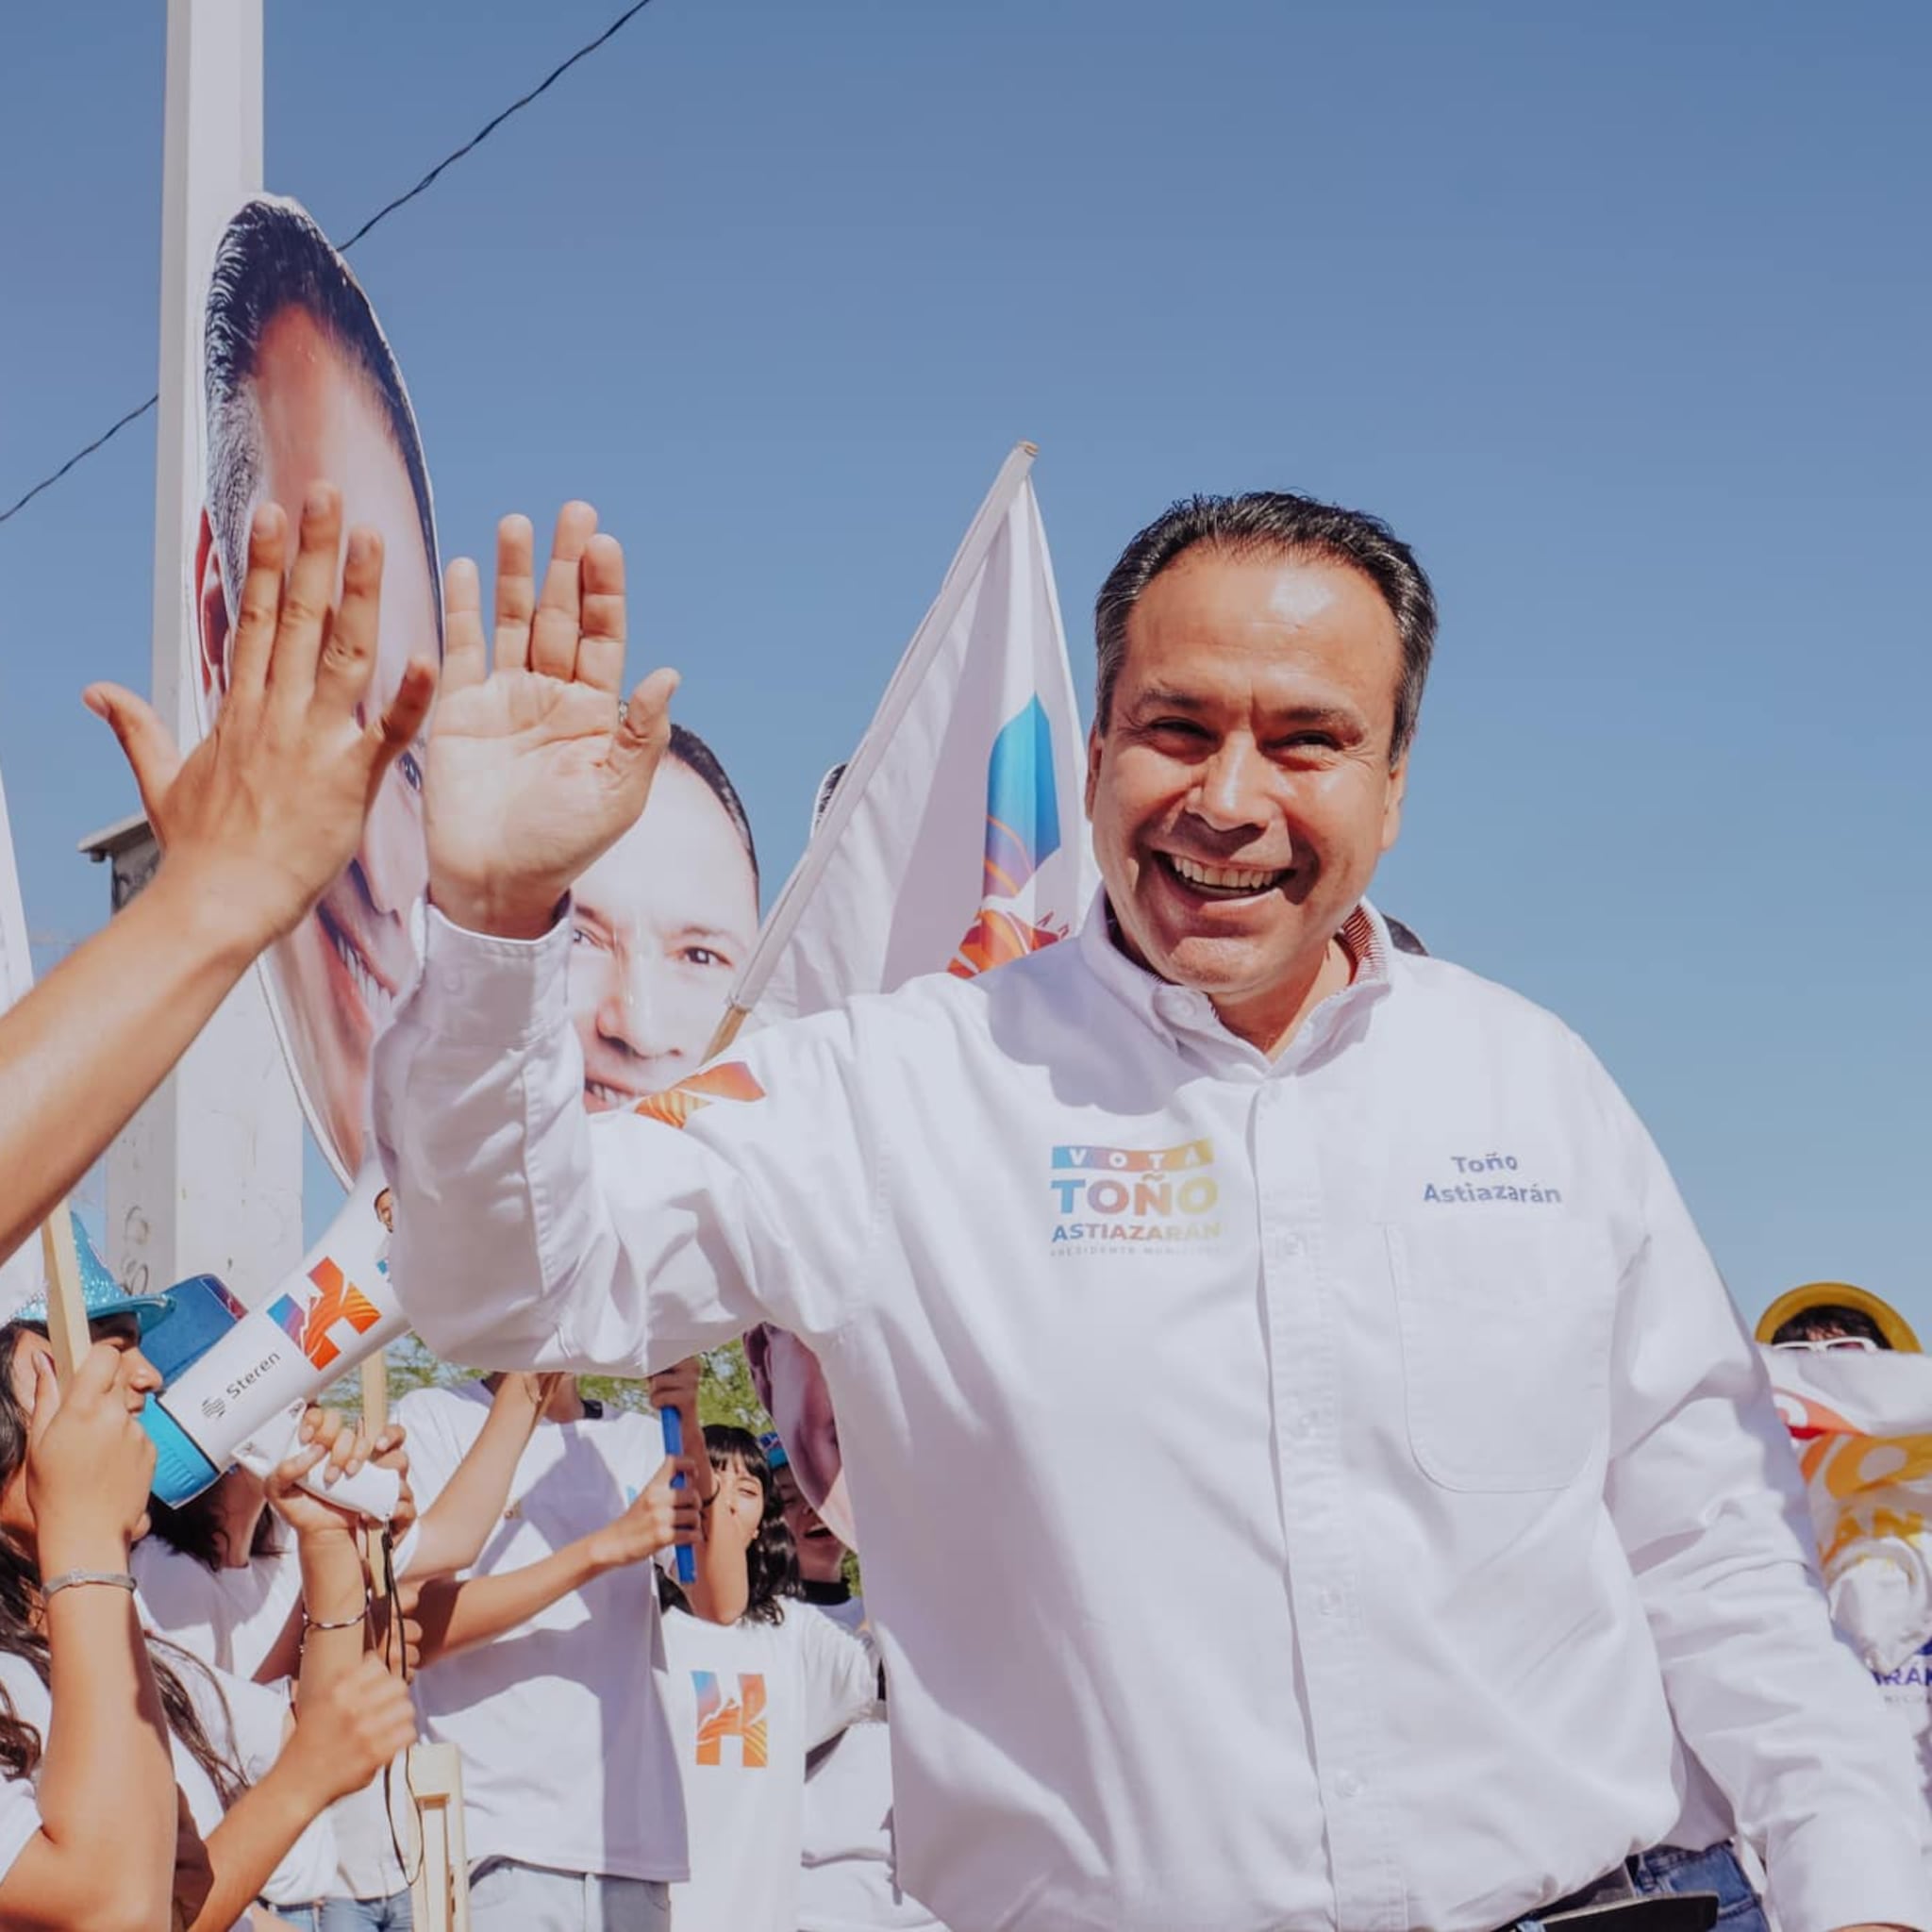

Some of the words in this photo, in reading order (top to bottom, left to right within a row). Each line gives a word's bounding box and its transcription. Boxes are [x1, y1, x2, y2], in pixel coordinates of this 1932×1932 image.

[1068, 1144, 1202, 1171] VOTA
[1450, 1151, 1519, 1174] Toño
[1050, 1171, 1219, 1217] TOÑO
[1423, 1183, 1562, 1204] Astiazarán
[226, 1352, 281, 1400] Steren
